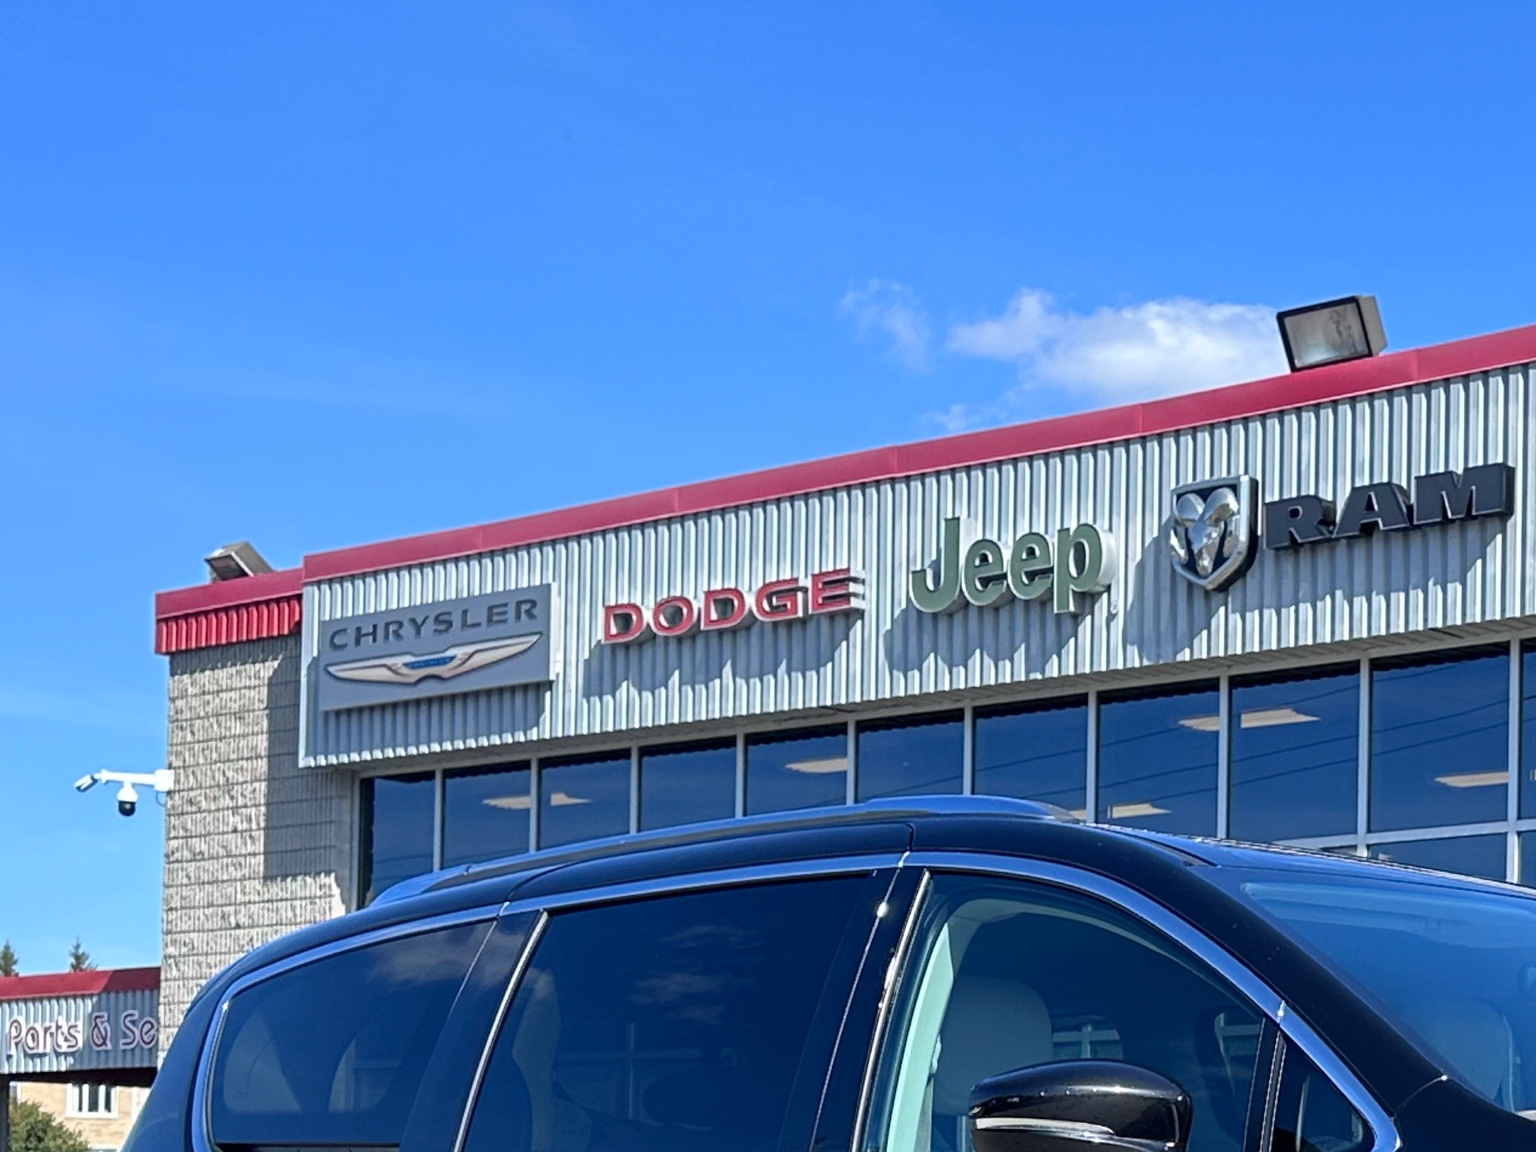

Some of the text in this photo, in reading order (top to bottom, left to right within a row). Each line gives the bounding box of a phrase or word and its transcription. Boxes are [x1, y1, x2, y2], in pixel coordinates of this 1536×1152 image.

[1262, 462, 1514, 551] RAM
[909, 517, 1112, 614] Jeep
[329, 599, 539, 650] CHRYSLER
[601, 567, 866, 644] DODGE
[8, 1016, 81, 1053] Parts
[91, 1011, 113, 1050] &
